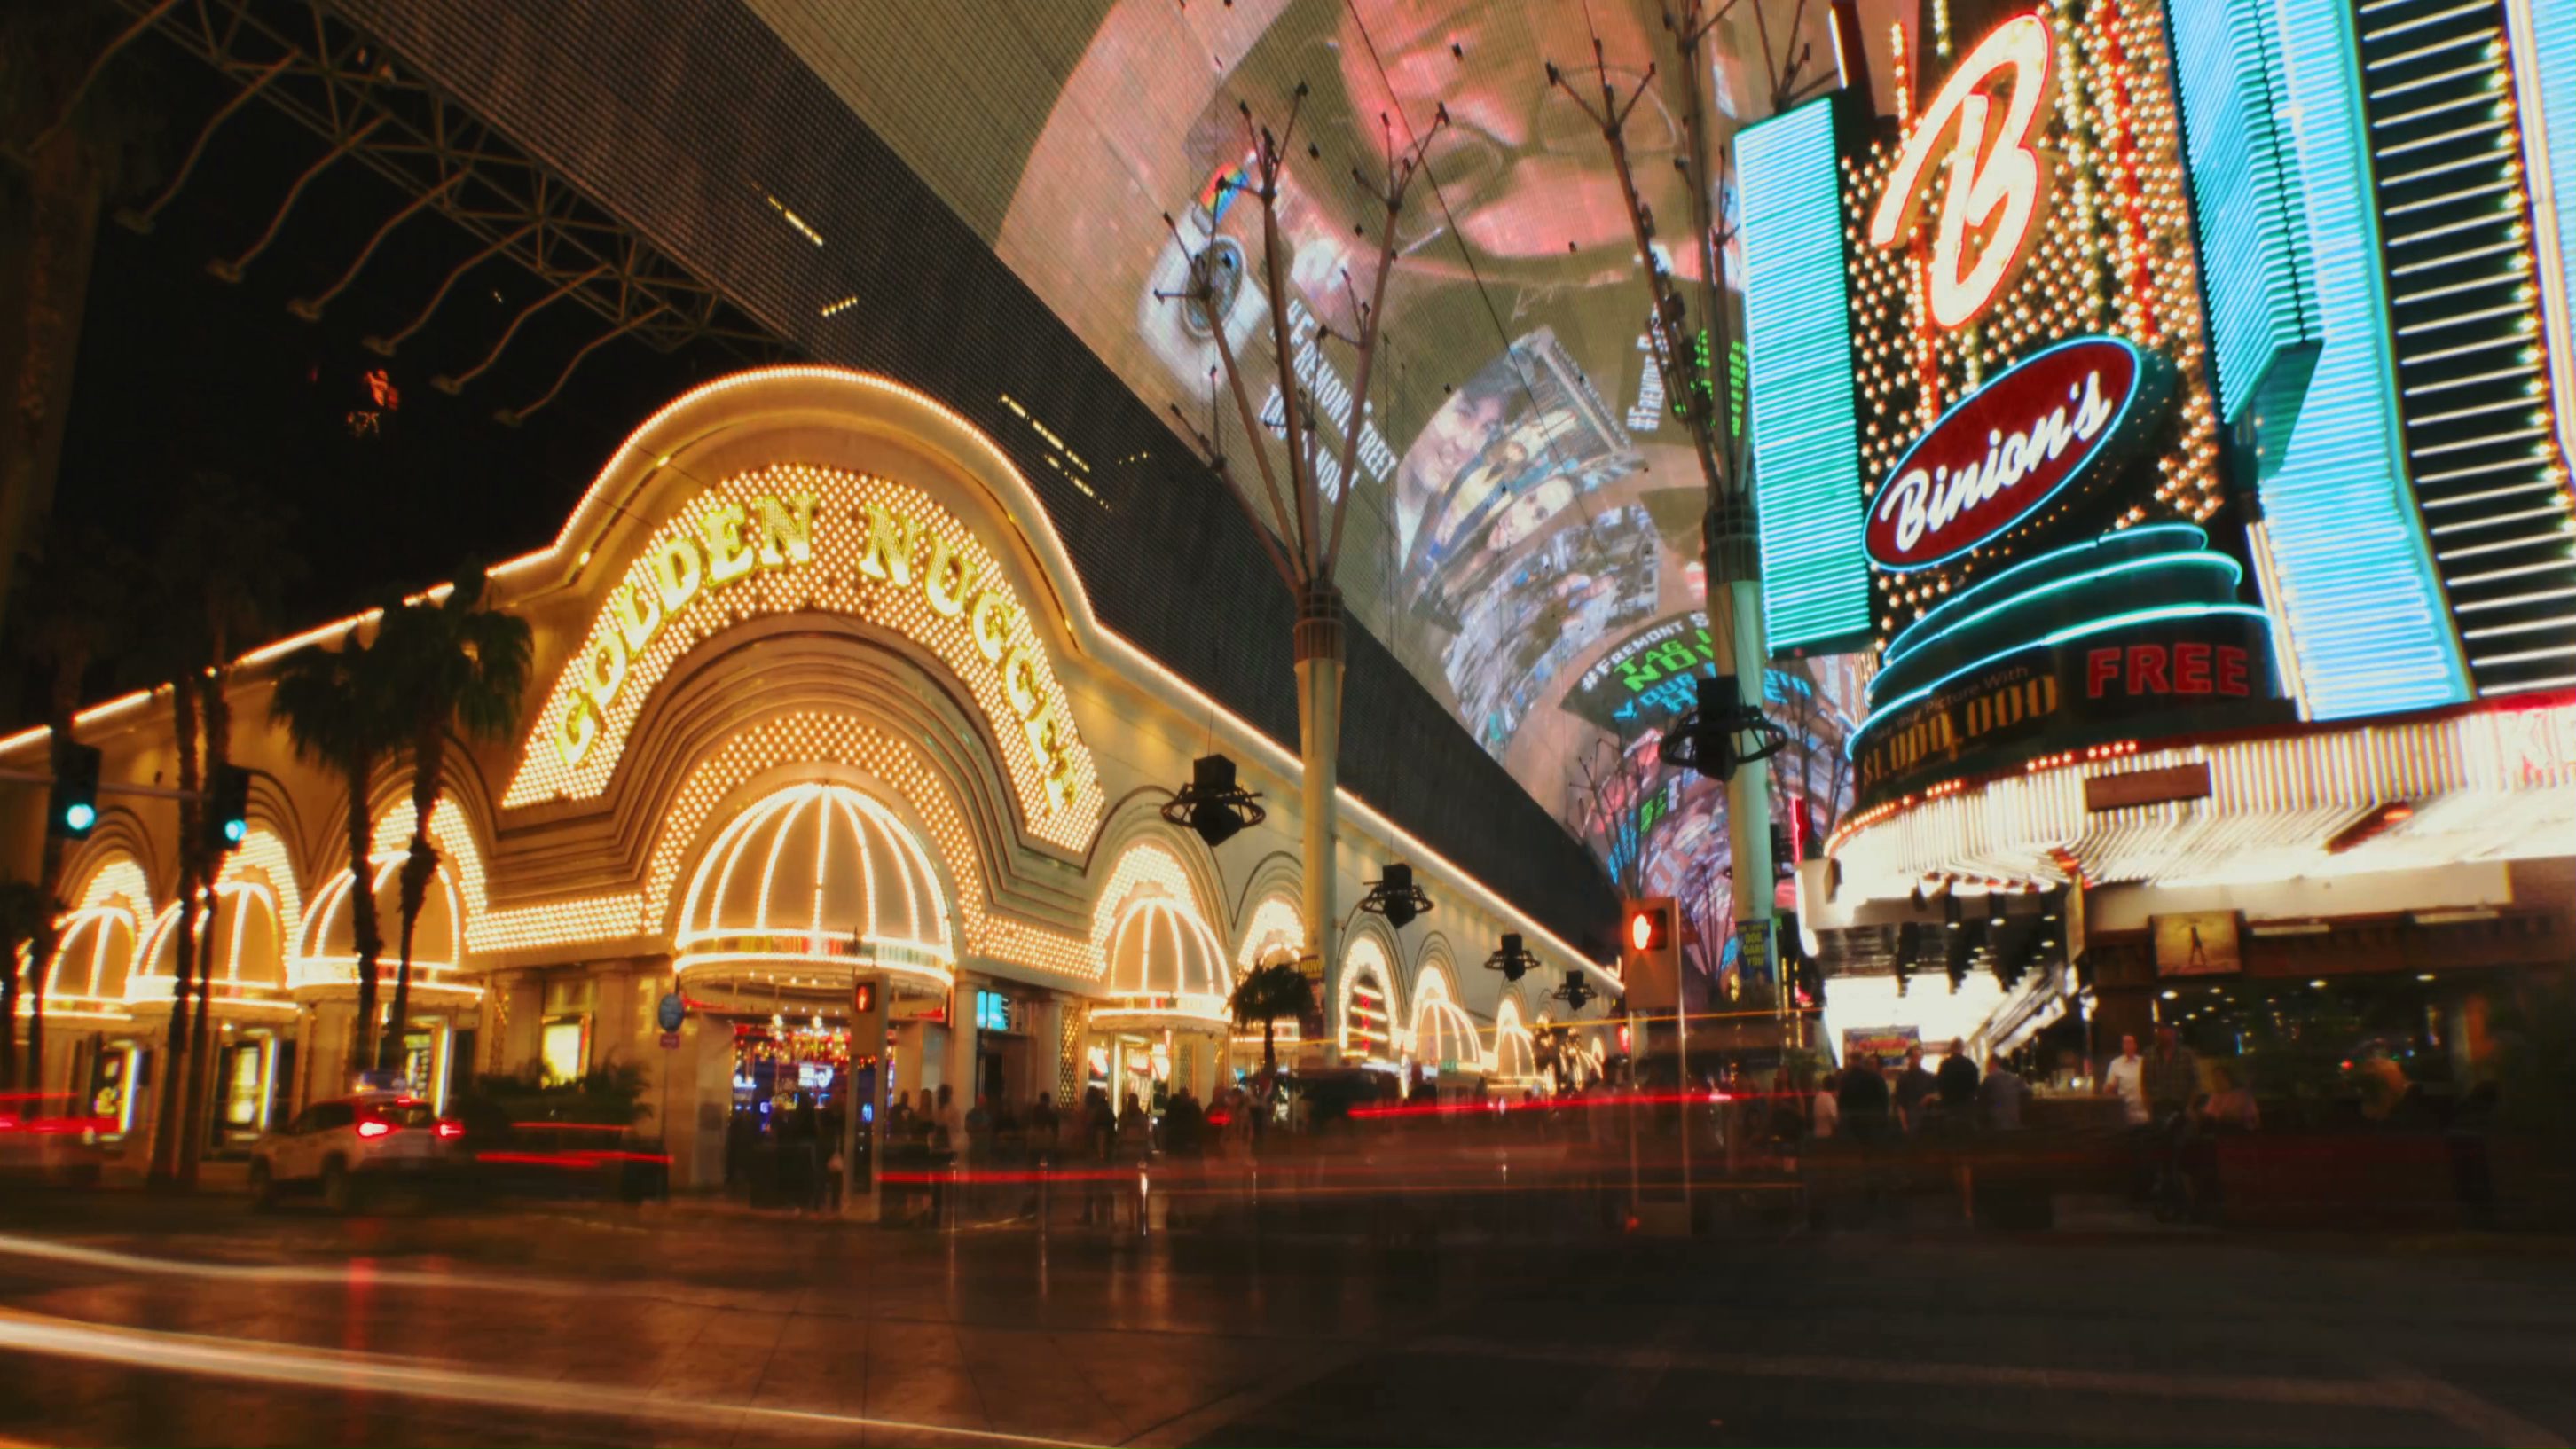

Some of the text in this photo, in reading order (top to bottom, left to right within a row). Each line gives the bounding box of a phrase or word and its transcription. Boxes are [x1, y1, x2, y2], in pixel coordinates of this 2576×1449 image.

[1871, 12, 2054, 329] B
[1878, 370, 2112, 553] Binion's
[556, 493, 1080, 814] GOLDEN NUGGET
[2086, 641, 2250, 699] FREE
